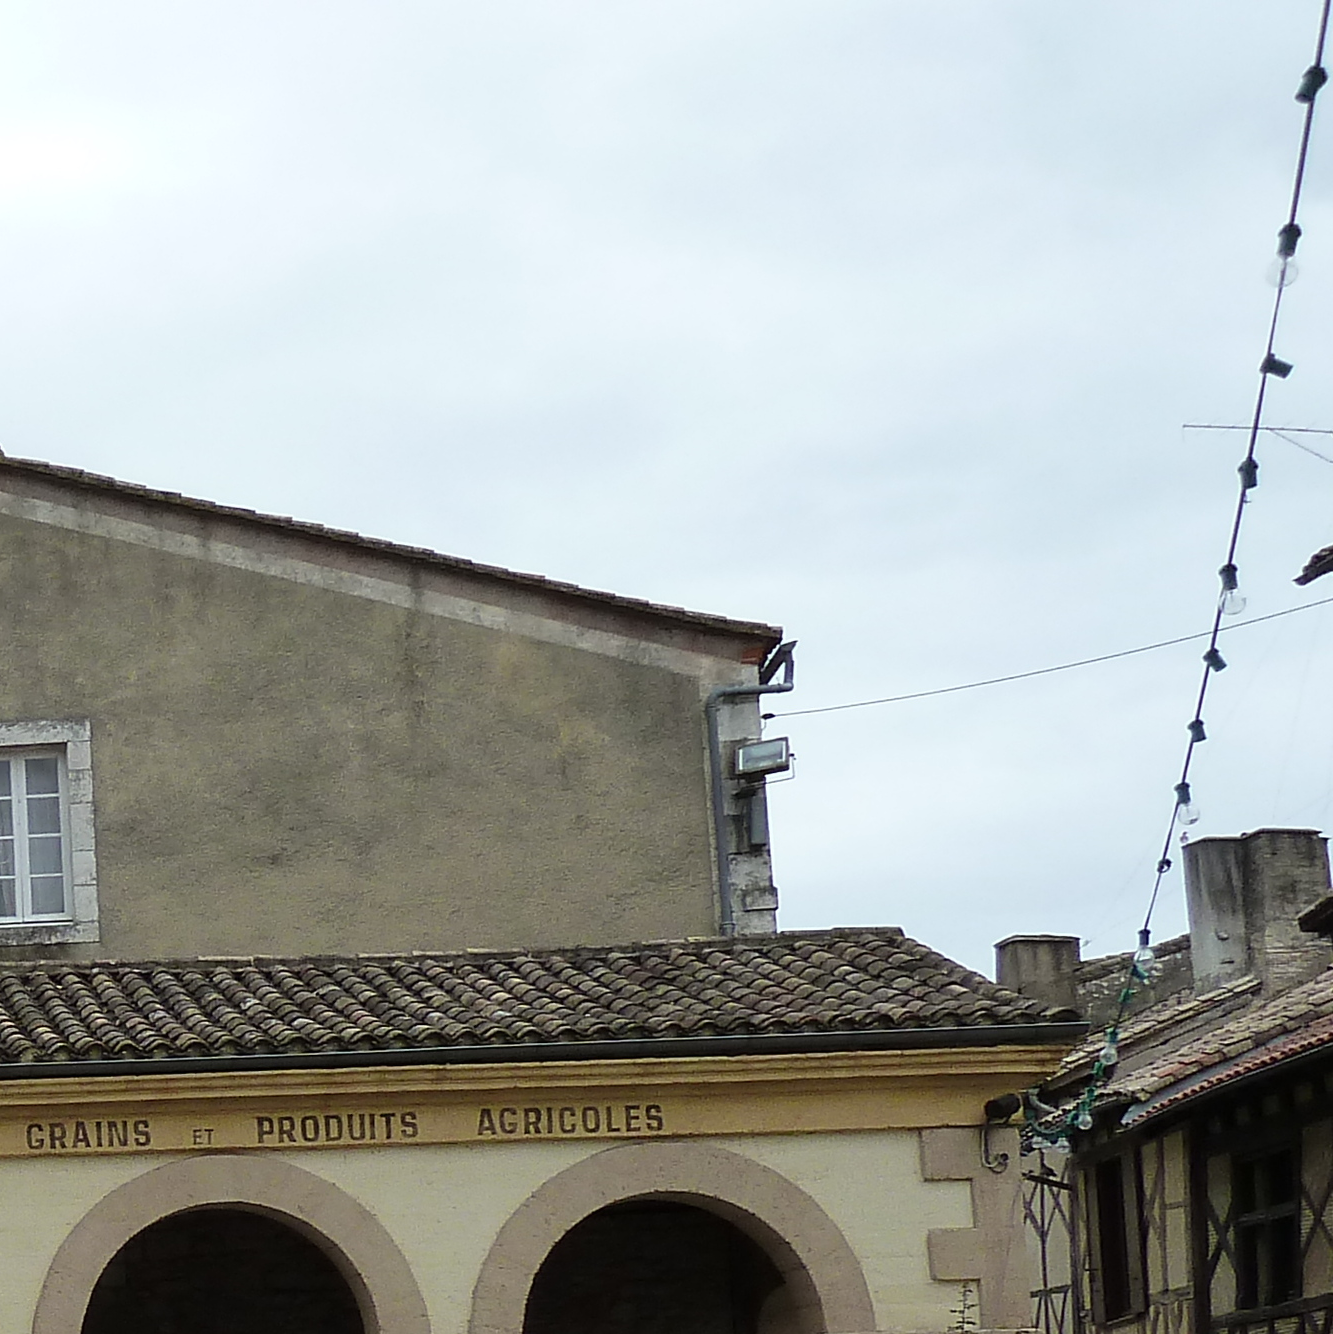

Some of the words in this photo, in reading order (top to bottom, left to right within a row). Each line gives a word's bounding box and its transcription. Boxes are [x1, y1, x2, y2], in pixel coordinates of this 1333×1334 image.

[26, 1119, 151, 1149] GRAINS
[192, 1129, 214, 1145] ET
[256, 1111, 418, 1143] PRODUITS
[477, 1104, 664, 1135] AGRICOLES
